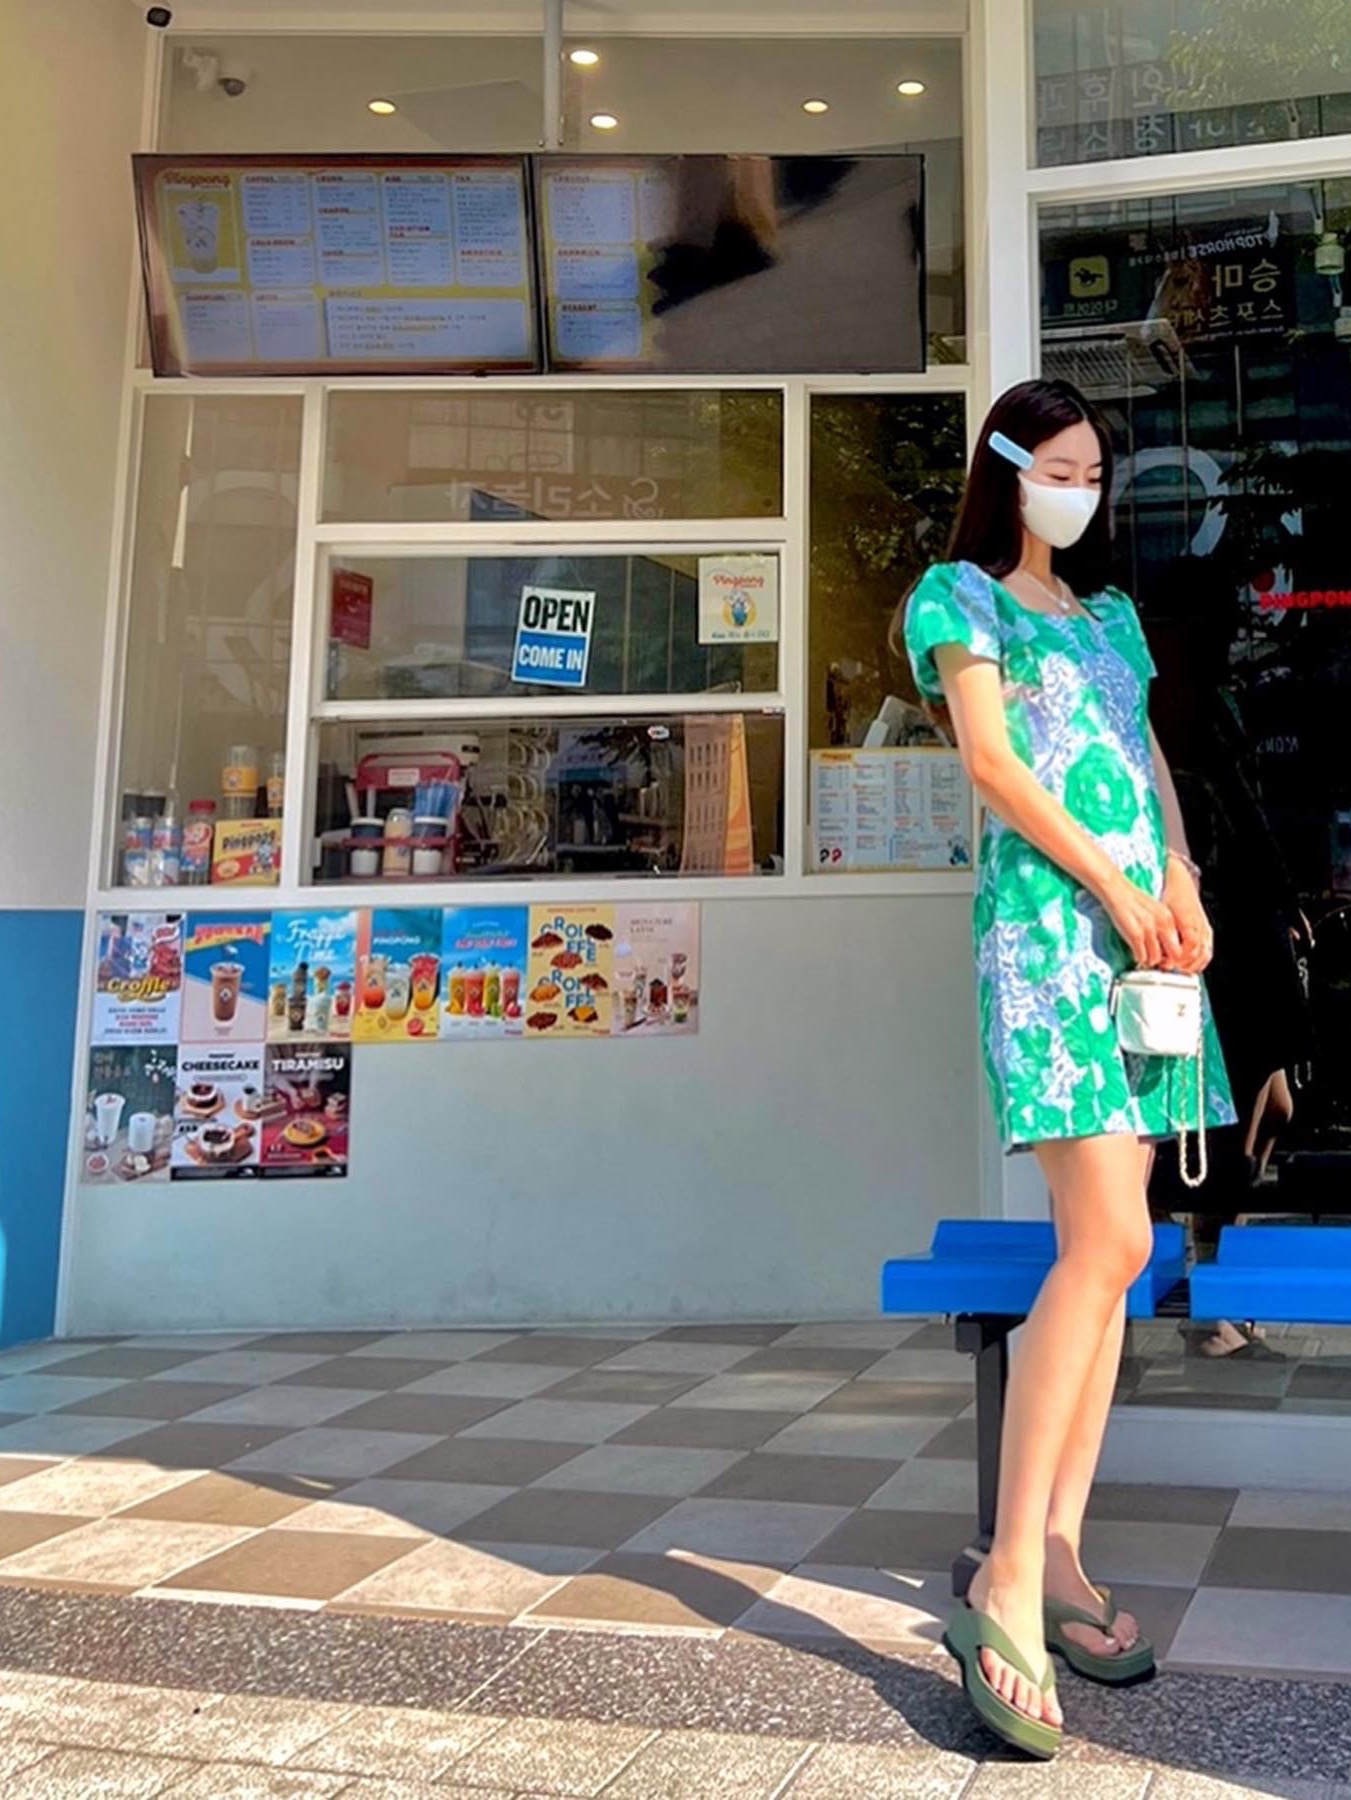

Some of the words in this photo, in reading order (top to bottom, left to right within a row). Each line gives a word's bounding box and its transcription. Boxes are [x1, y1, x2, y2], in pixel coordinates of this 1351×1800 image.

[523, 595, 590, 633] OPEN
[518, 643, 566, 669] COME
[566, 647, 584, 671] IN
[182, 1060, 259, 1072] CHEESECAKE
[272, 1057, 344, 1072] TIRAMISU
